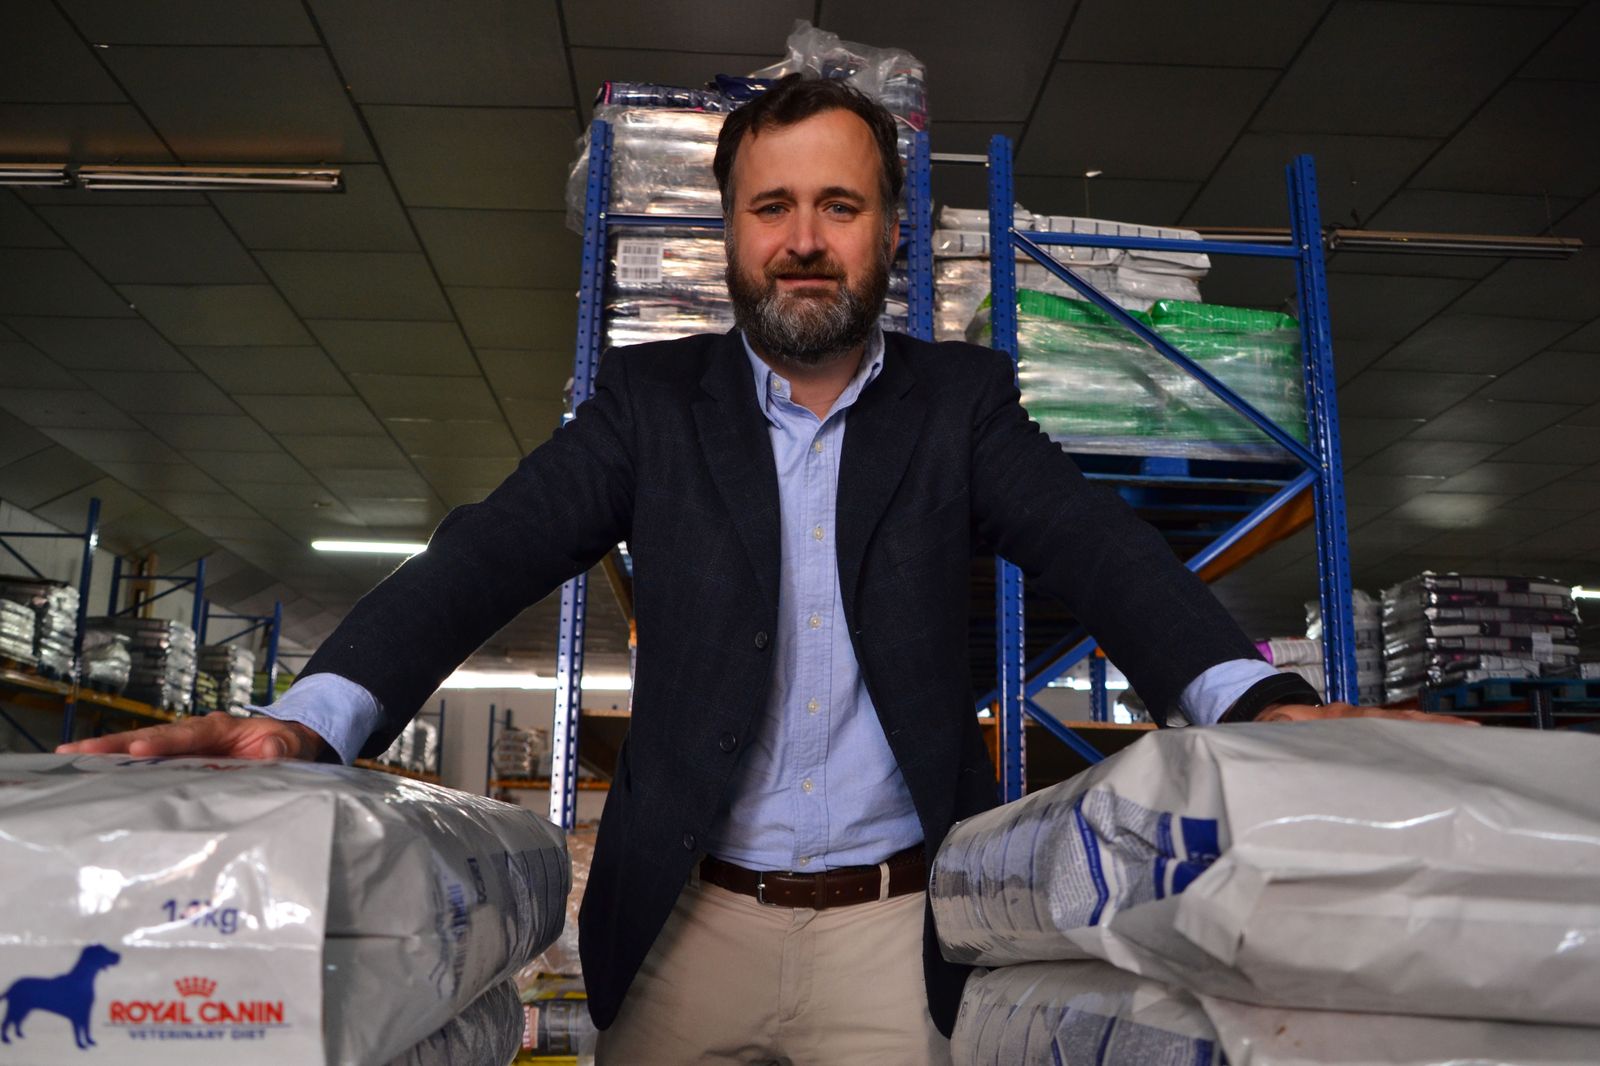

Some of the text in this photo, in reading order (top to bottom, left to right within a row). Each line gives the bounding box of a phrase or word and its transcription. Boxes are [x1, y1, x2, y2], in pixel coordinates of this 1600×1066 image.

[110, 1001, 283, 1024] ROYAL CANIN
[128, 1029, 267, 1040] VETERINARY DIET
